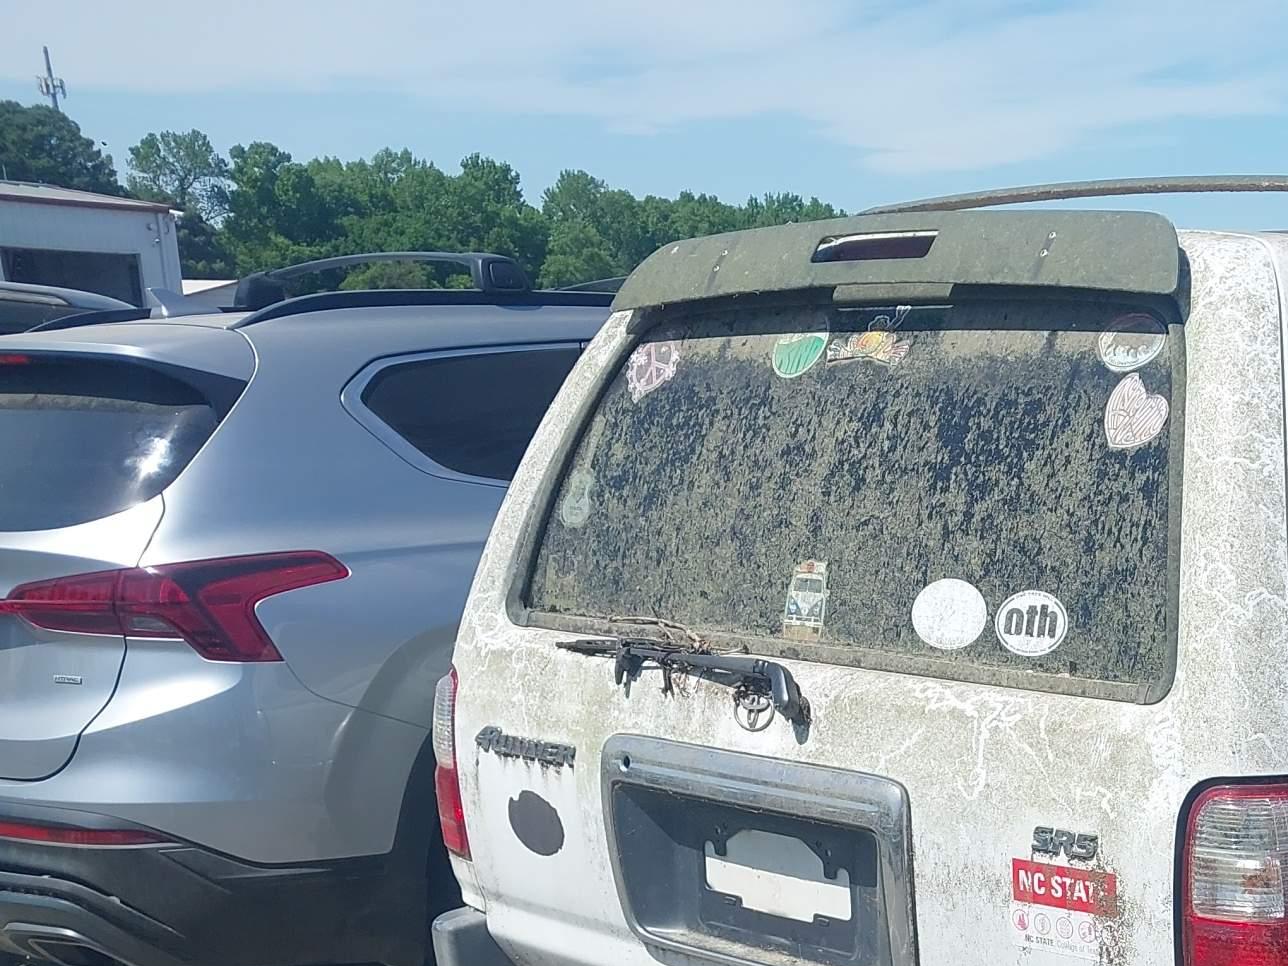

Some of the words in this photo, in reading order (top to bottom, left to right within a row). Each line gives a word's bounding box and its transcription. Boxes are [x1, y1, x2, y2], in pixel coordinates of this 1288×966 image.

[1031, 826, 1098, 861] SR5
[1018, 869, 1046, 895] NC
[1050, 875, 1108, 904] STAT
